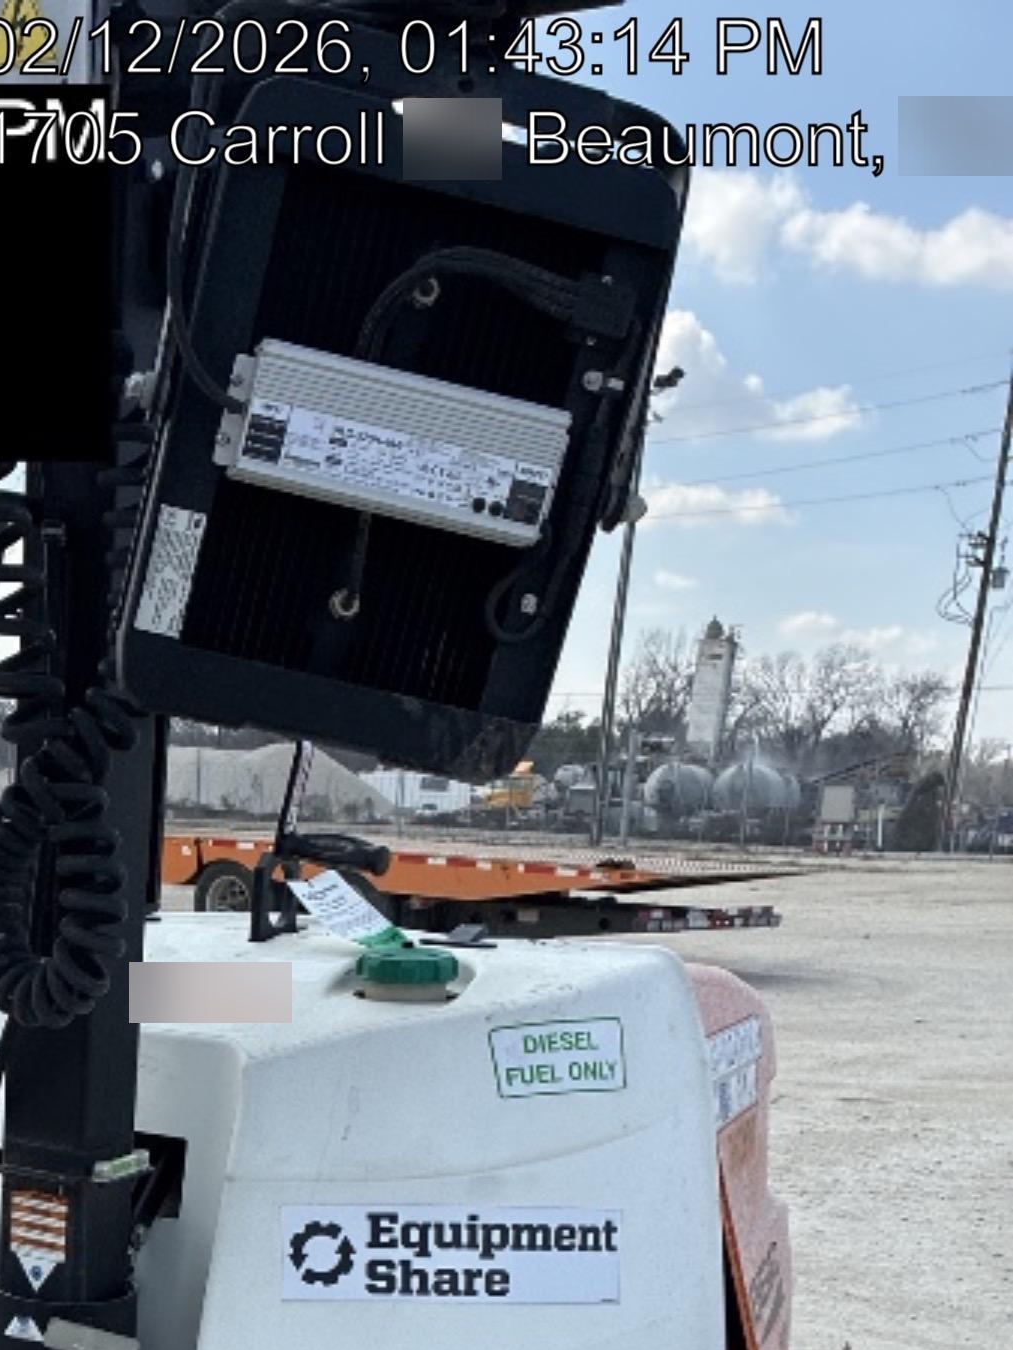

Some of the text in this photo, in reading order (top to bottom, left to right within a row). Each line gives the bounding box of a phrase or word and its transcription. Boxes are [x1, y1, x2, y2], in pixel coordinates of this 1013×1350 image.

[522, 1030, 600, 1054] DIESEL
[505, 1060, 618, 1087] FUEL ONLY
[365, 1211, 619, 1259] Equipment
[365, 1258, 510, 1297] Share
